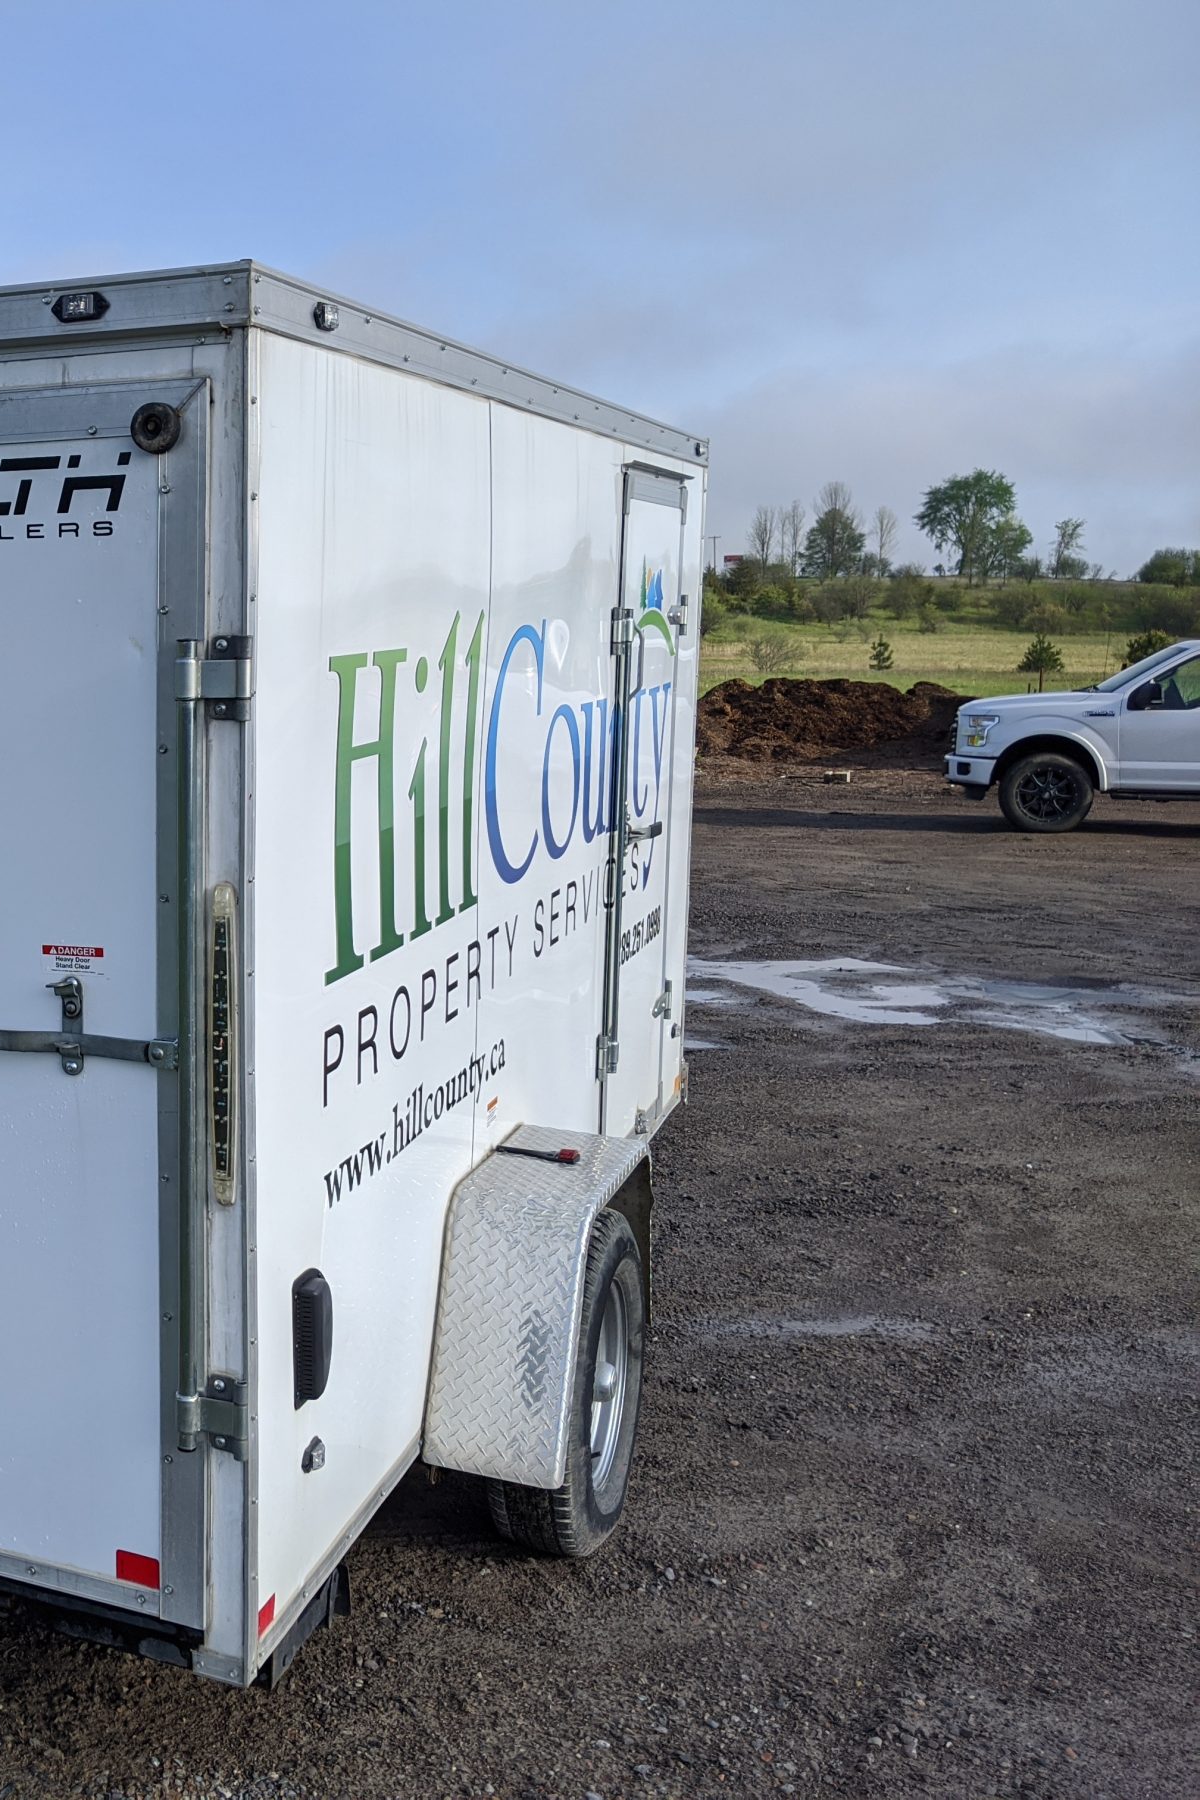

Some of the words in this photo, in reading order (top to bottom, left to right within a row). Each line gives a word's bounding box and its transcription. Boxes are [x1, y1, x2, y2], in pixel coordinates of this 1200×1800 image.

[57, 946, 96, 956] DANGER
[618, 904, 661, 968] 89.251.0998
[322, 915, 519, 1108] PROPERTY
[323, 1038, 506, 1209] www.hillcounty.ca
